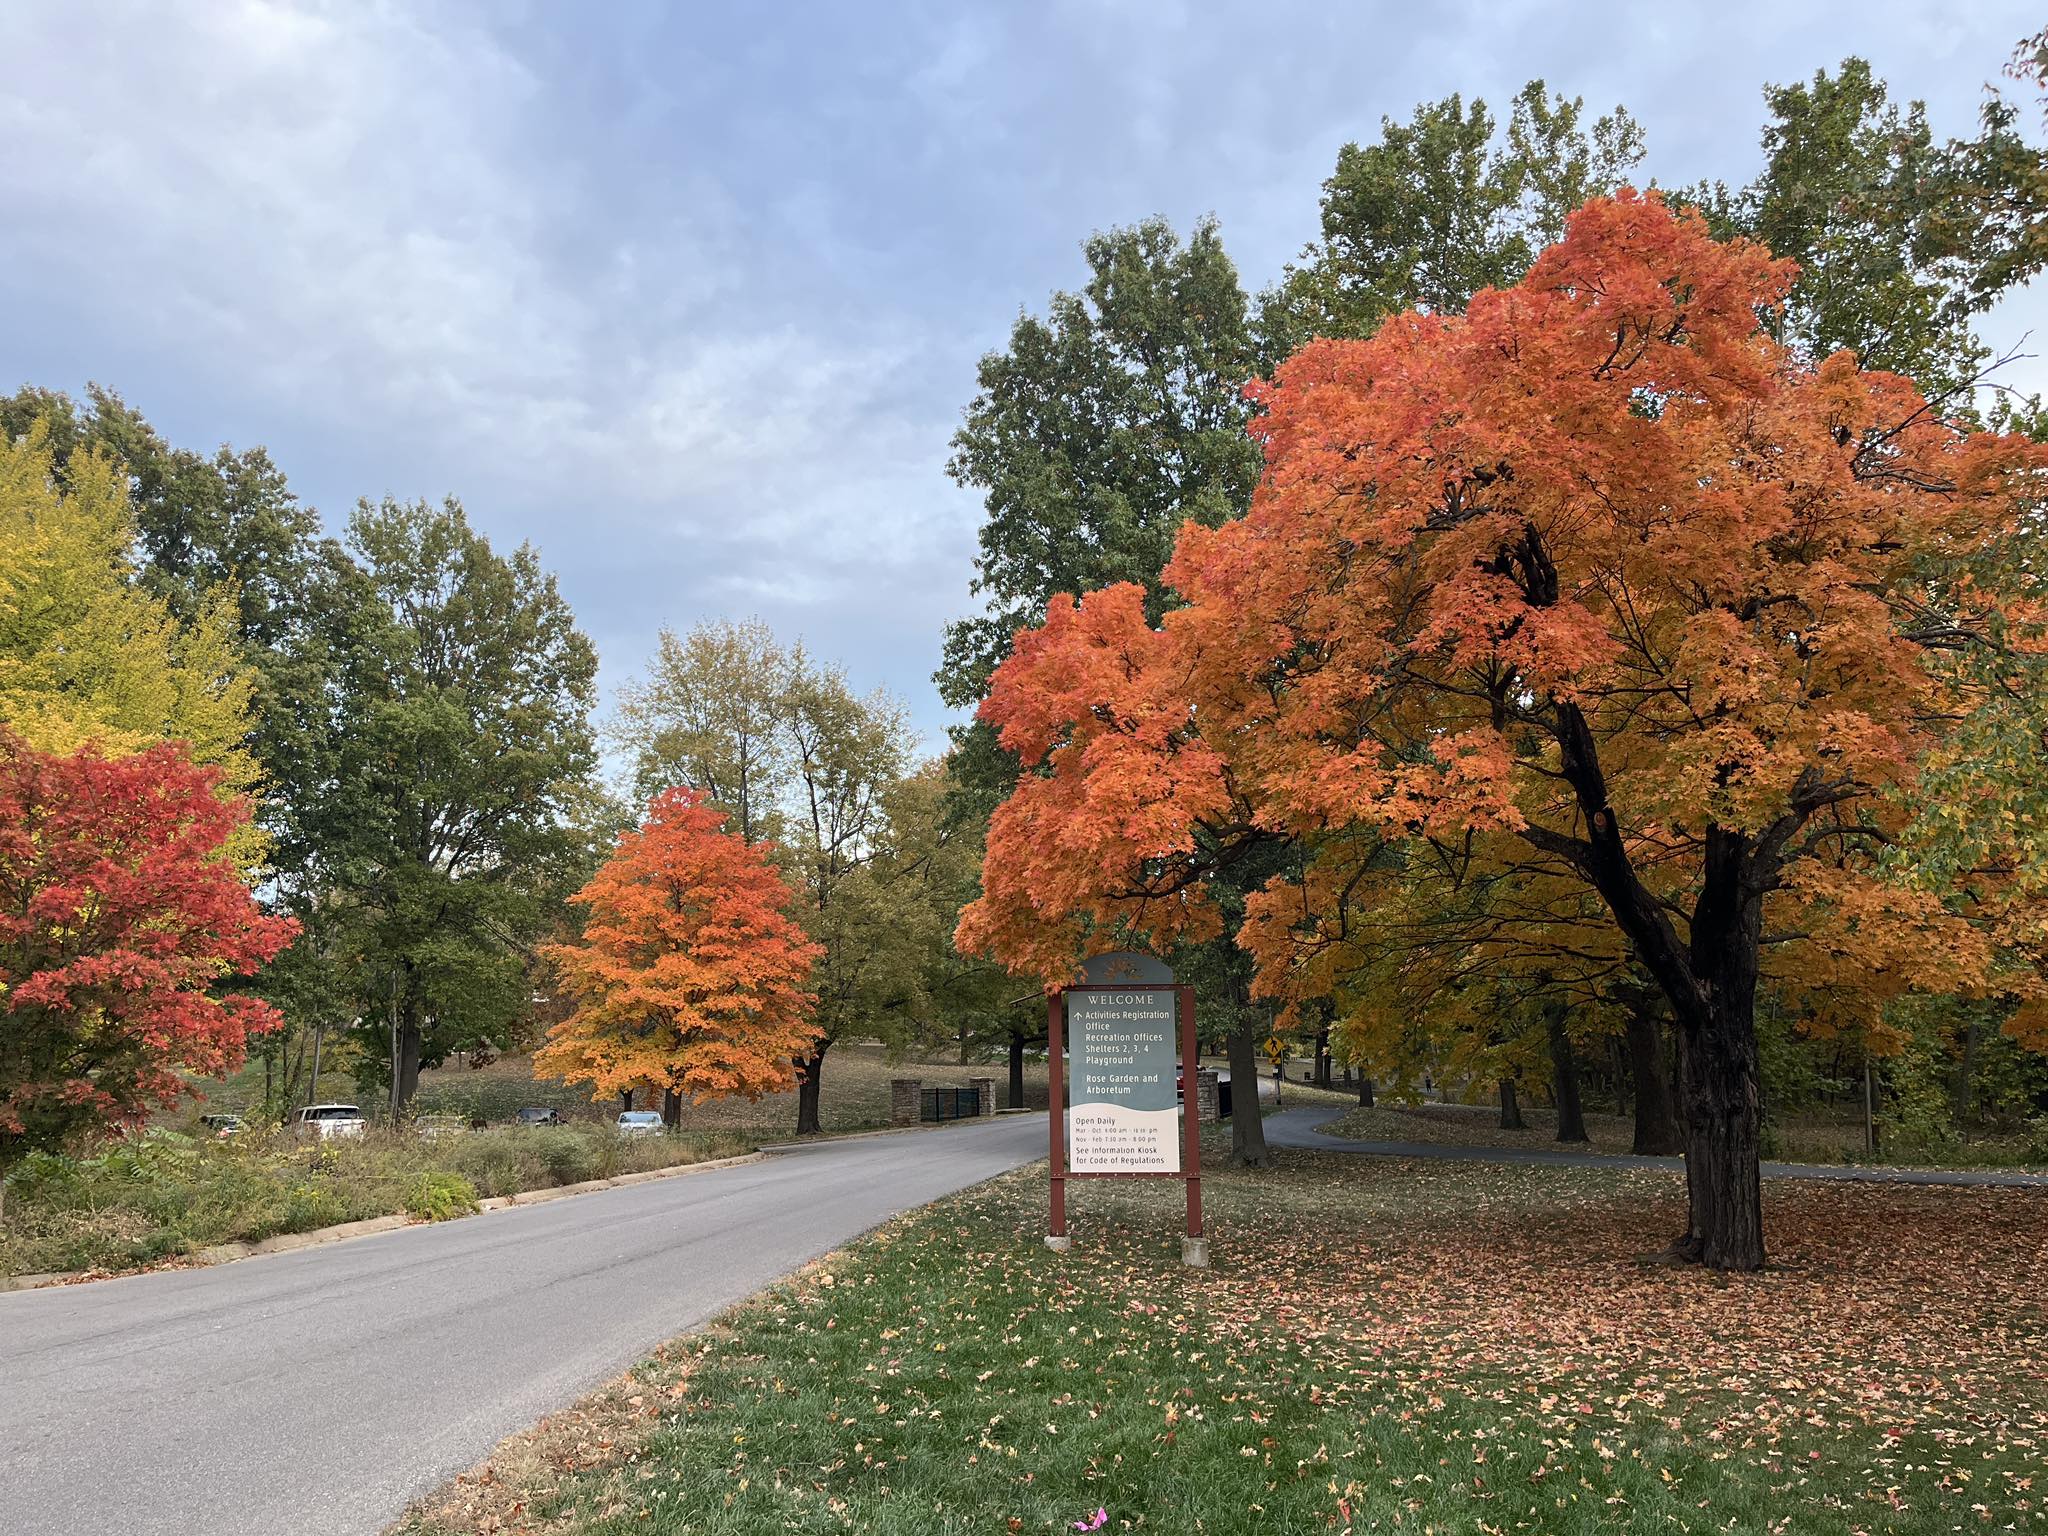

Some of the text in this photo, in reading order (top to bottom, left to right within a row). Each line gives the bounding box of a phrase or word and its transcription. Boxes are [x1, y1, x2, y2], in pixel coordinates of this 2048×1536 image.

[1088, 995, 1154, 1005] WELCOME
[1085, 1010, 1170, 1021] Activities Registration
[1085, 1022, 1110, 1031] Office
[1085, 1033, 1163, 1042] Recreation Offices
[1086, 1044, 1149, 1054] Shelters 2, 3, 4
[1086, 1056, 1134, 1066] Playground
[1086, 1074, 1158, 1083] Rose Garden and
[1086, 1086, 1131, 1094] Arboretum
[1076, 1117, 1116, 1126] Open Daily
[1121, 1157, 1165, 1166] Regulations
